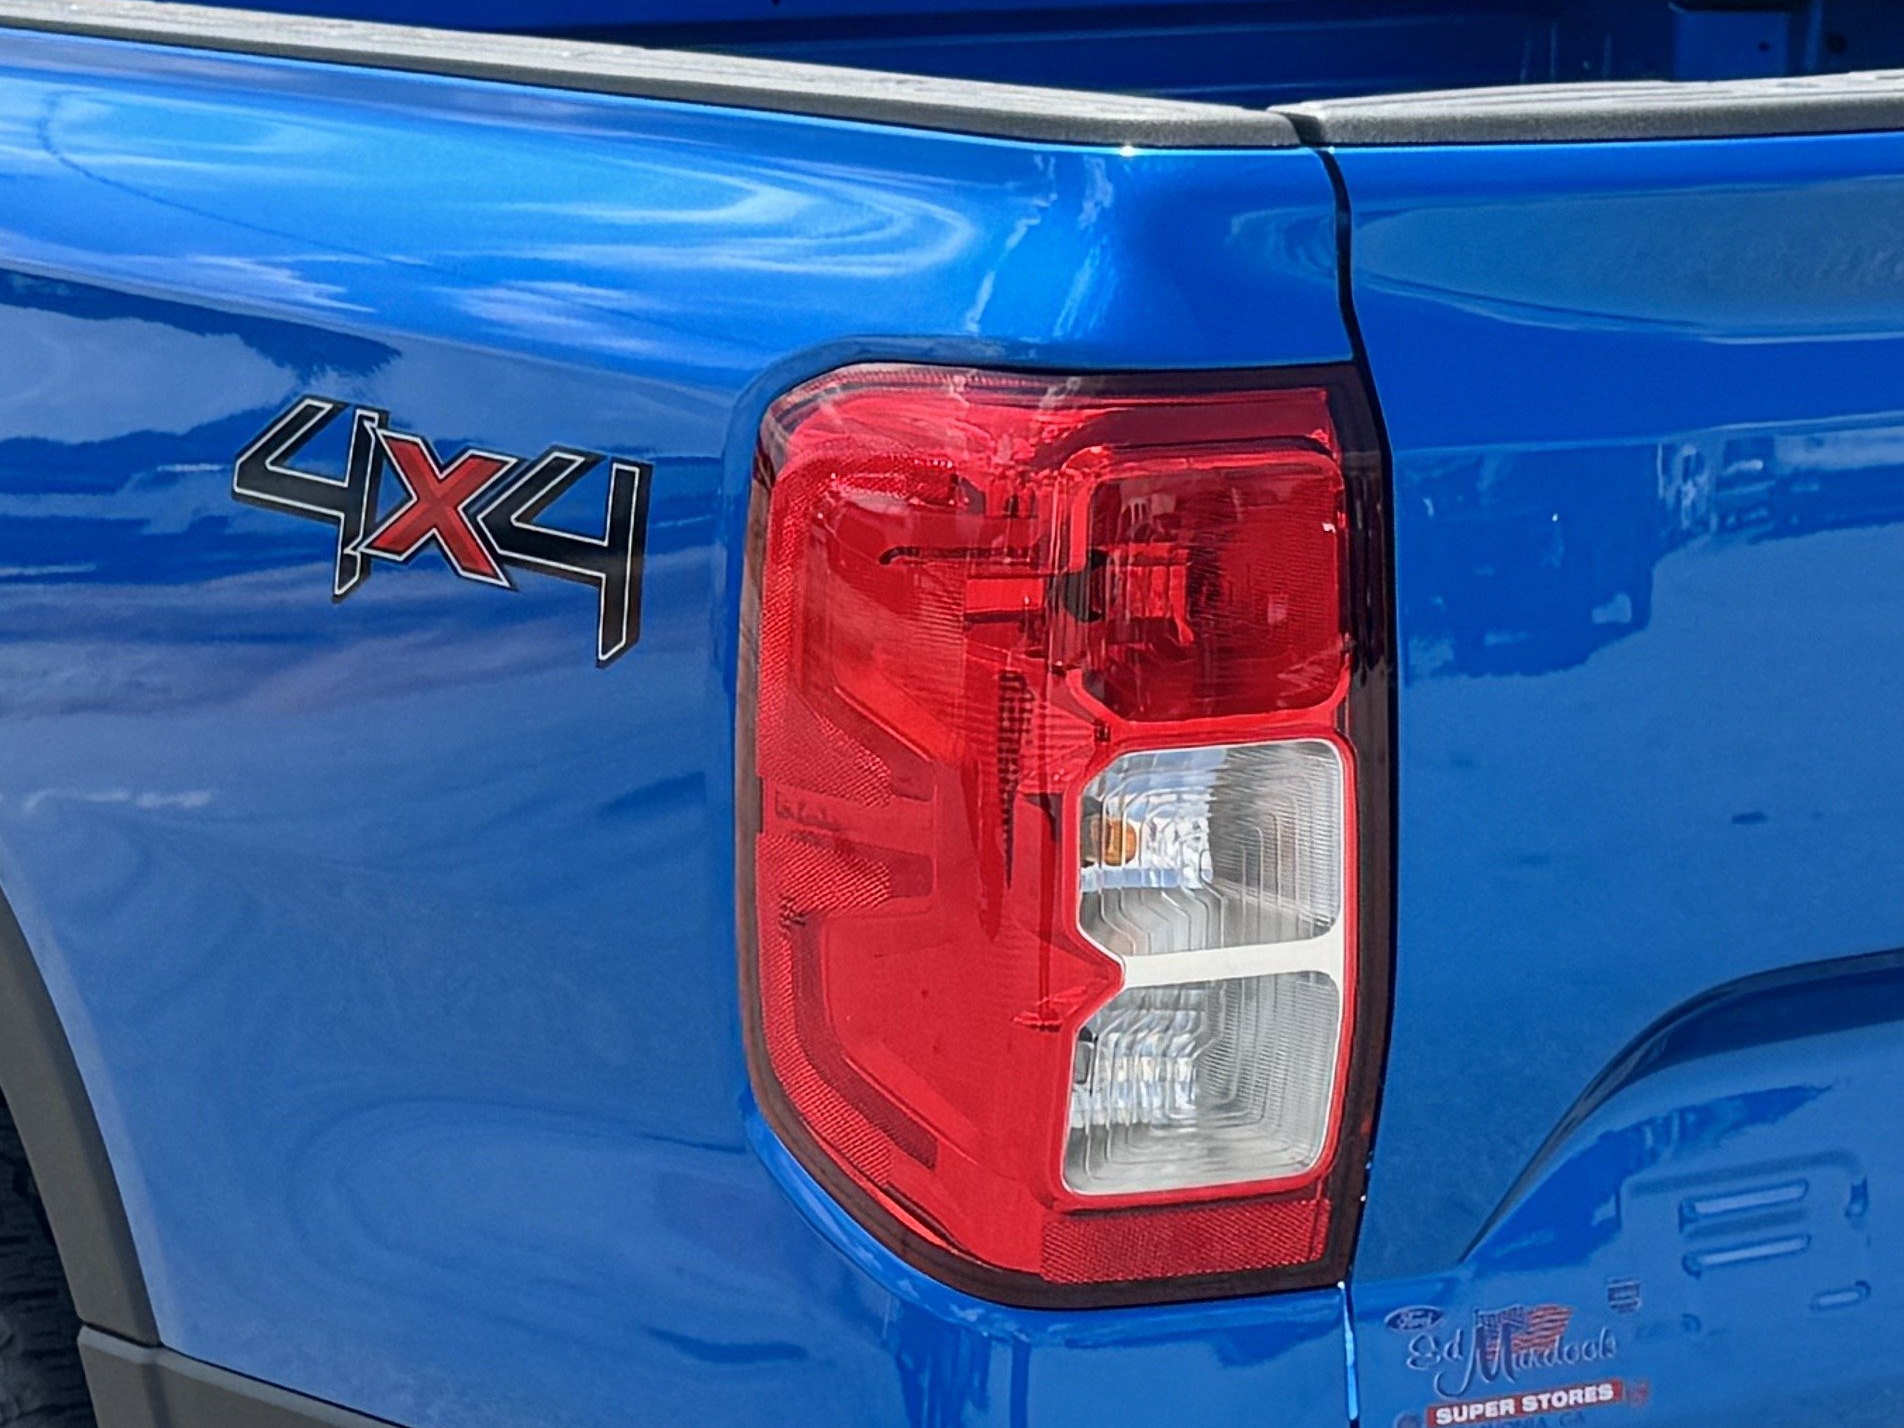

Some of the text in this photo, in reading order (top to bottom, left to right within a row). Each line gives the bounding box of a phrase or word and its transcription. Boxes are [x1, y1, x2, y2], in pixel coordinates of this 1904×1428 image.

[1406, 1329, 1464, 1370] Ed
[1435, 1383, 1614, 1427] SUPER STORES
